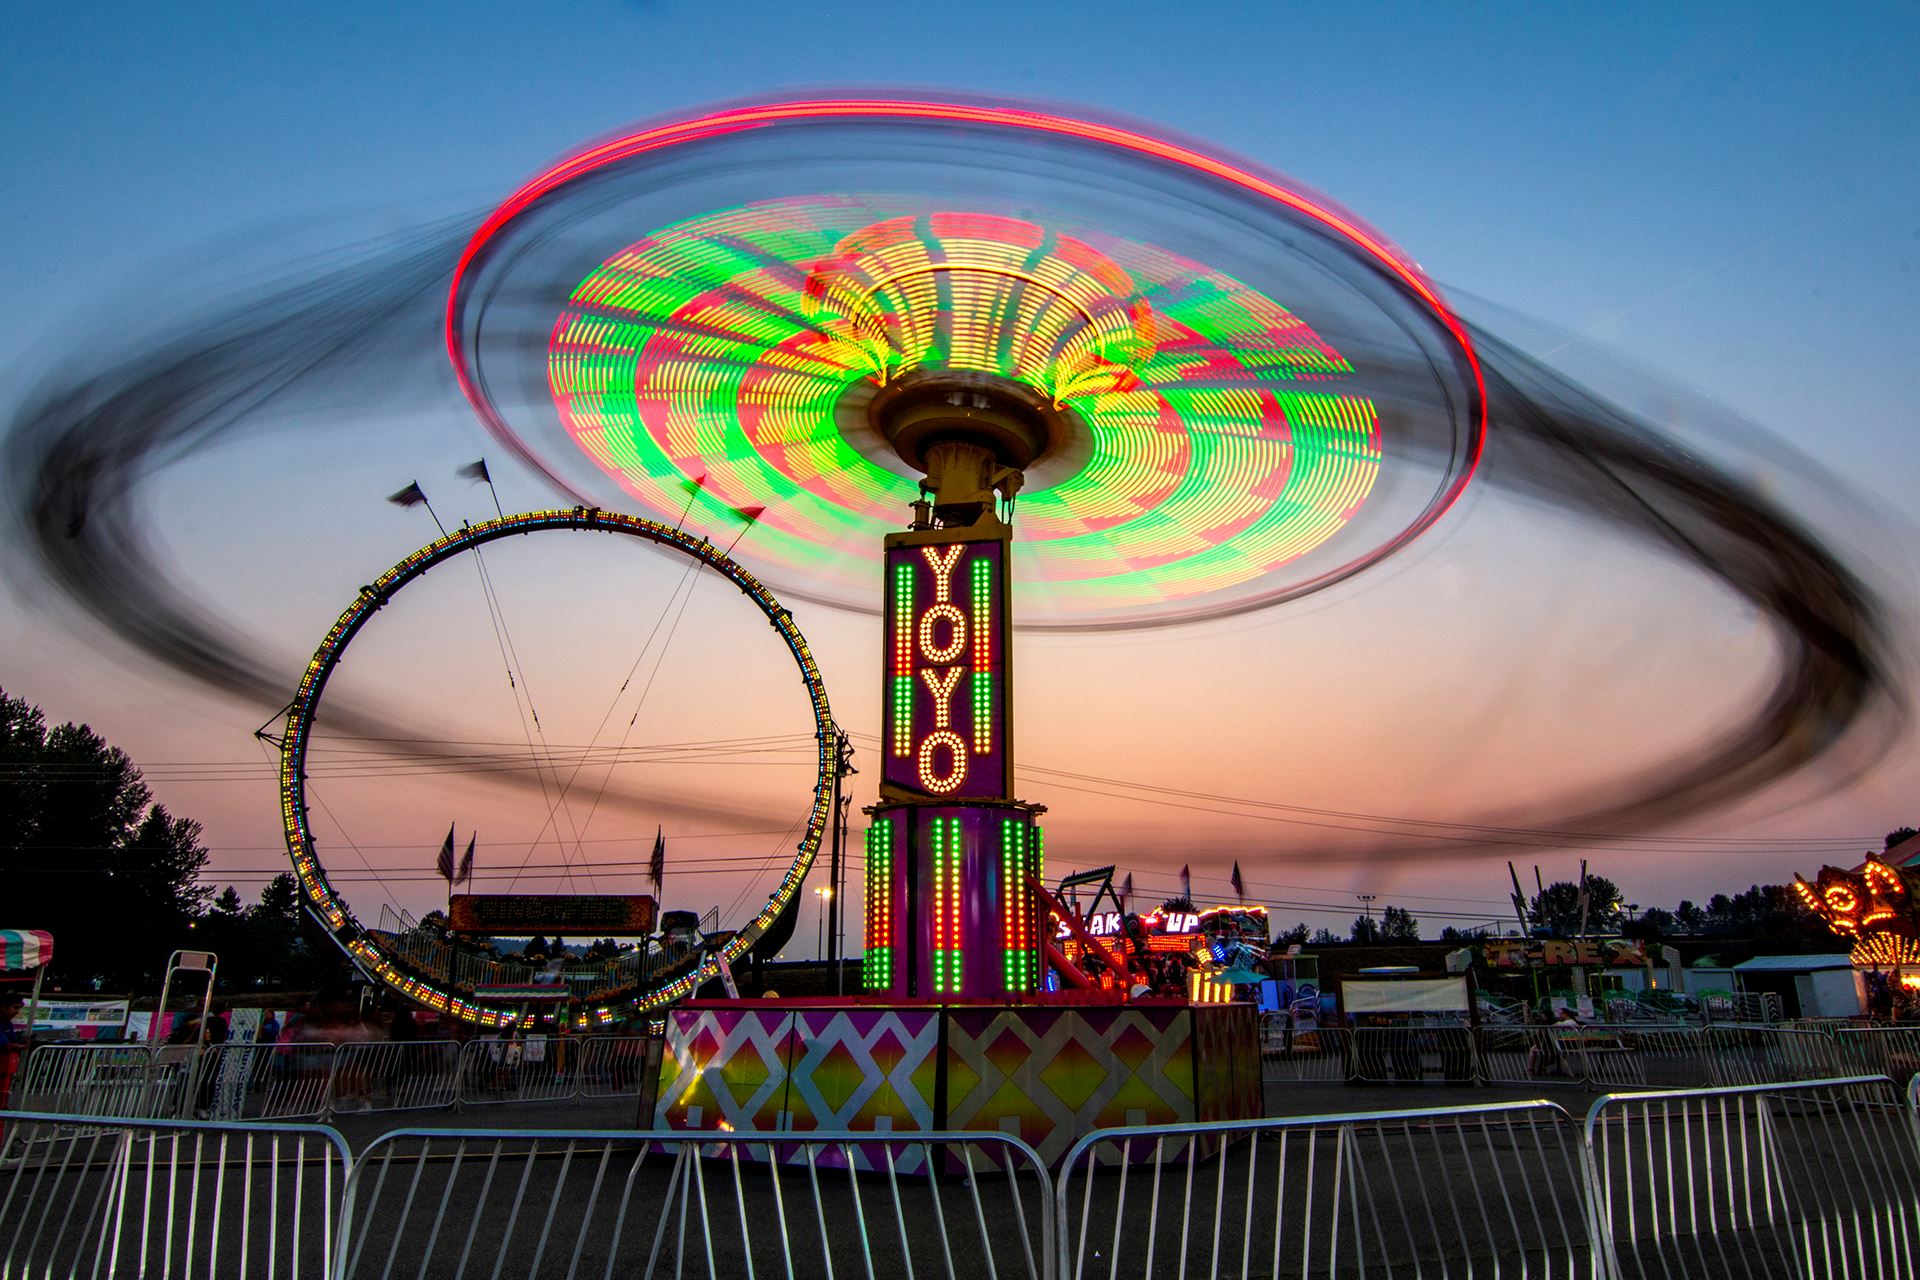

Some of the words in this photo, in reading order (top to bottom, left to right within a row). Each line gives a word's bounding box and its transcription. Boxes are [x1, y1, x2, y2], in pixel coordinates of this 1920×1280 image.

[919, 544, 967, 795] YOYO
[1166, 912, 1200, 933] UP
[1490, 940, 1646, 968] T-REX
